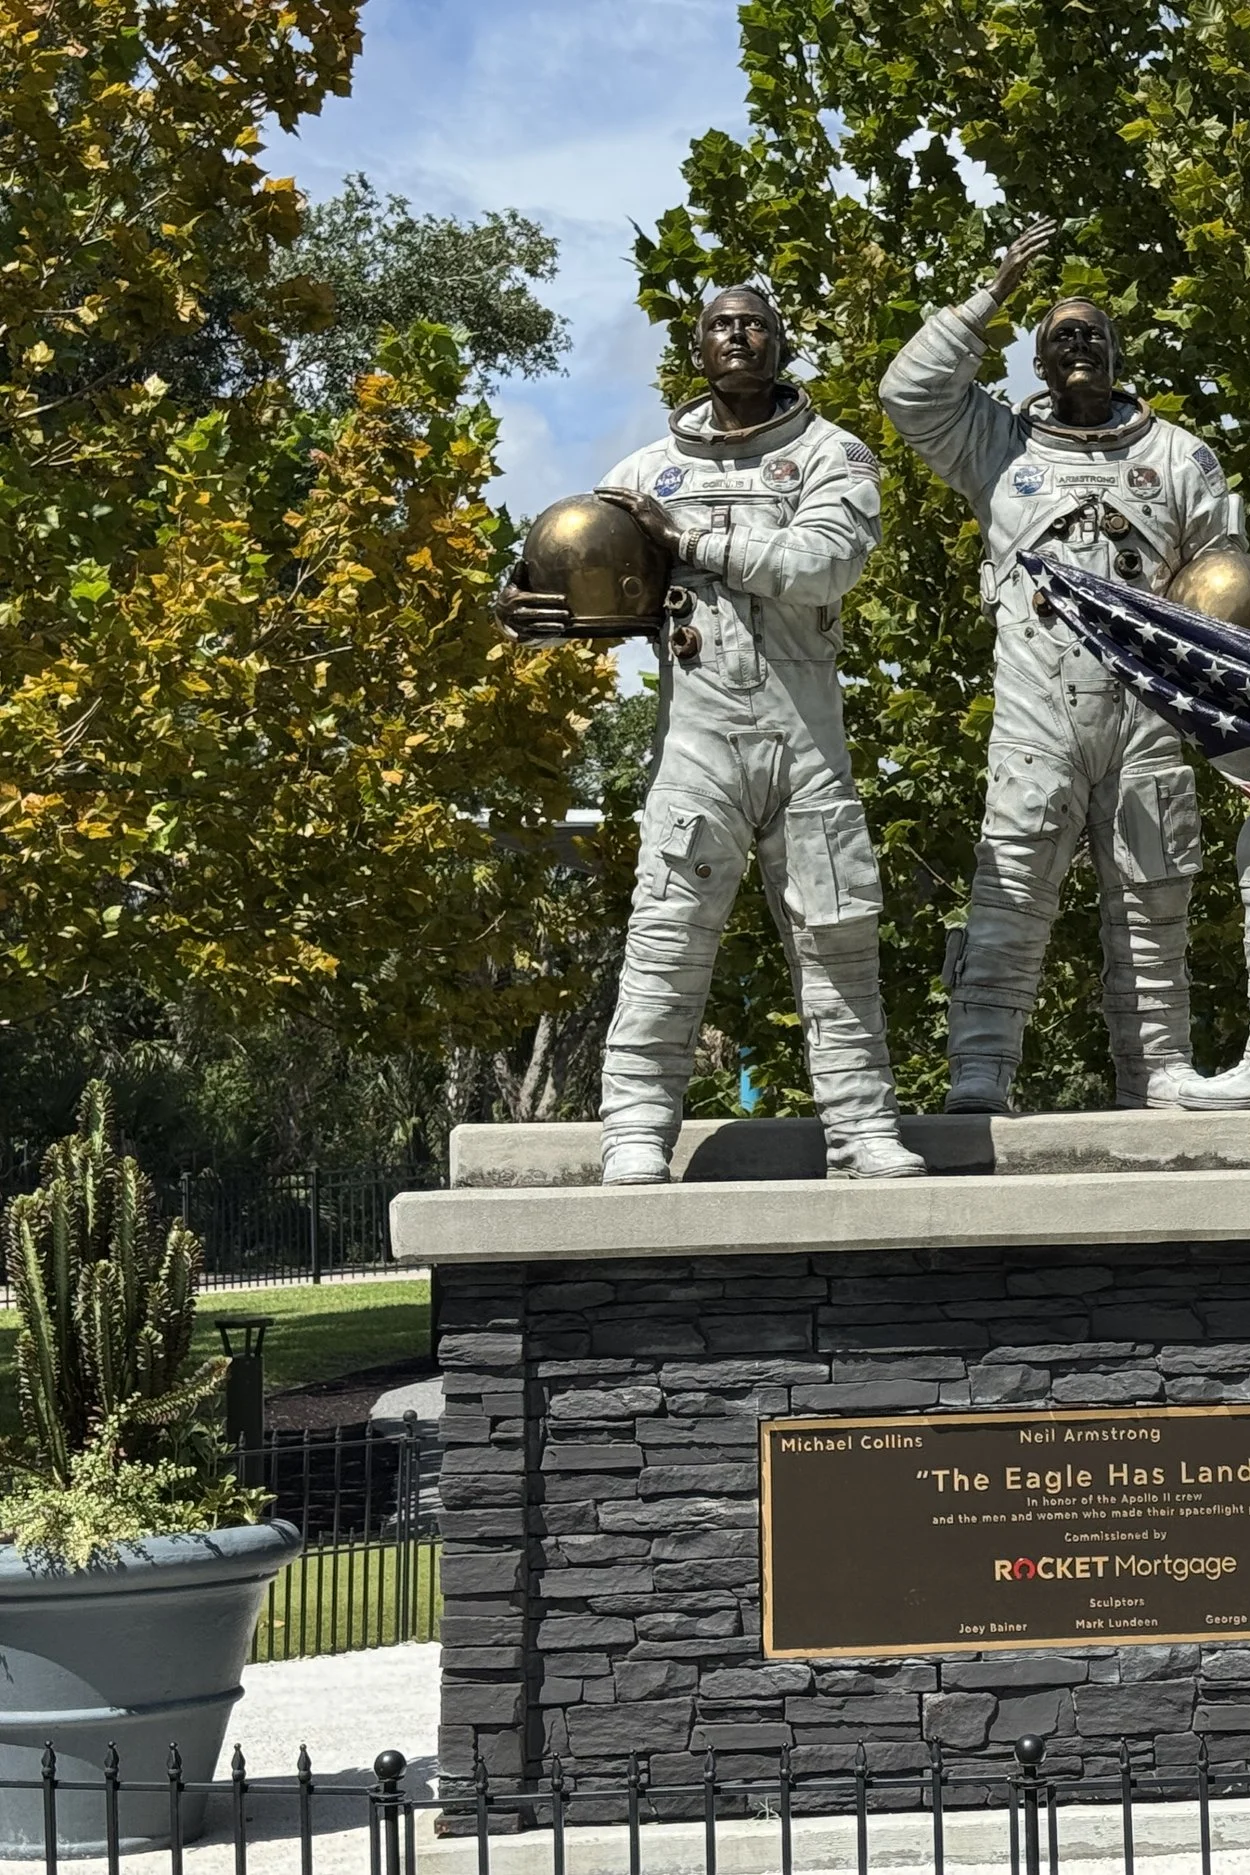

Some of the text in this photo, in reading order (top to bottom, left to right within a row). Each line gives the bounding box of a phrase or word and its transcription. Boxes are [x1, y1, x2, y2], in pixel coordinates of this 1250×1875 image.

[1058, 475, 1116, 485] ARMSTRONG
[1019, 1426, 1161, 1444] Neil Armstrong
[781, 1433, 923, 1453] Michael Collins
[916, 1467, 990, 1493] "The
[1005, 1463, 1093, 1495] Eagle
[1108, 1463, 1165, 1486] Has
[1026, 1496, 1038, 1507] In
[1042, 1496, 1077, 1507] honor
[1080, 1494, 1093, 1505] of
[1096, 1494, 1117, 1504] the
[1121, 1492, 1159, 1505] Apollo
[1175, 1493, 1203, 1502] crew
[932, 1513, 954, 1525] and
[958, 1513, 978, 1524] the
[982, 1514, 1007, 1523] men
[1011, 1510, 1033, 1522] and
[1036, 1511, 1078, 1521] women
[1082, 1508, 1107, 1519] who
[1111, 1507, 1143, 1518] made
[1147, 1506, 1175, 1517] their
[1179, 1503, 1244, 1518] spaceflight
[1064, 1529, 1167, 1543] Commissioned by
[994, 1553, 1237, 1582] ROCKET Mortgage
[1089, 1596, 1145, 1609] Sculptors
[1075, 1616, 1158, 1629] Mark Lundeen
[1205, 1614, 1248, 1626] George
[958, 1623, 986, 1635] Joey
